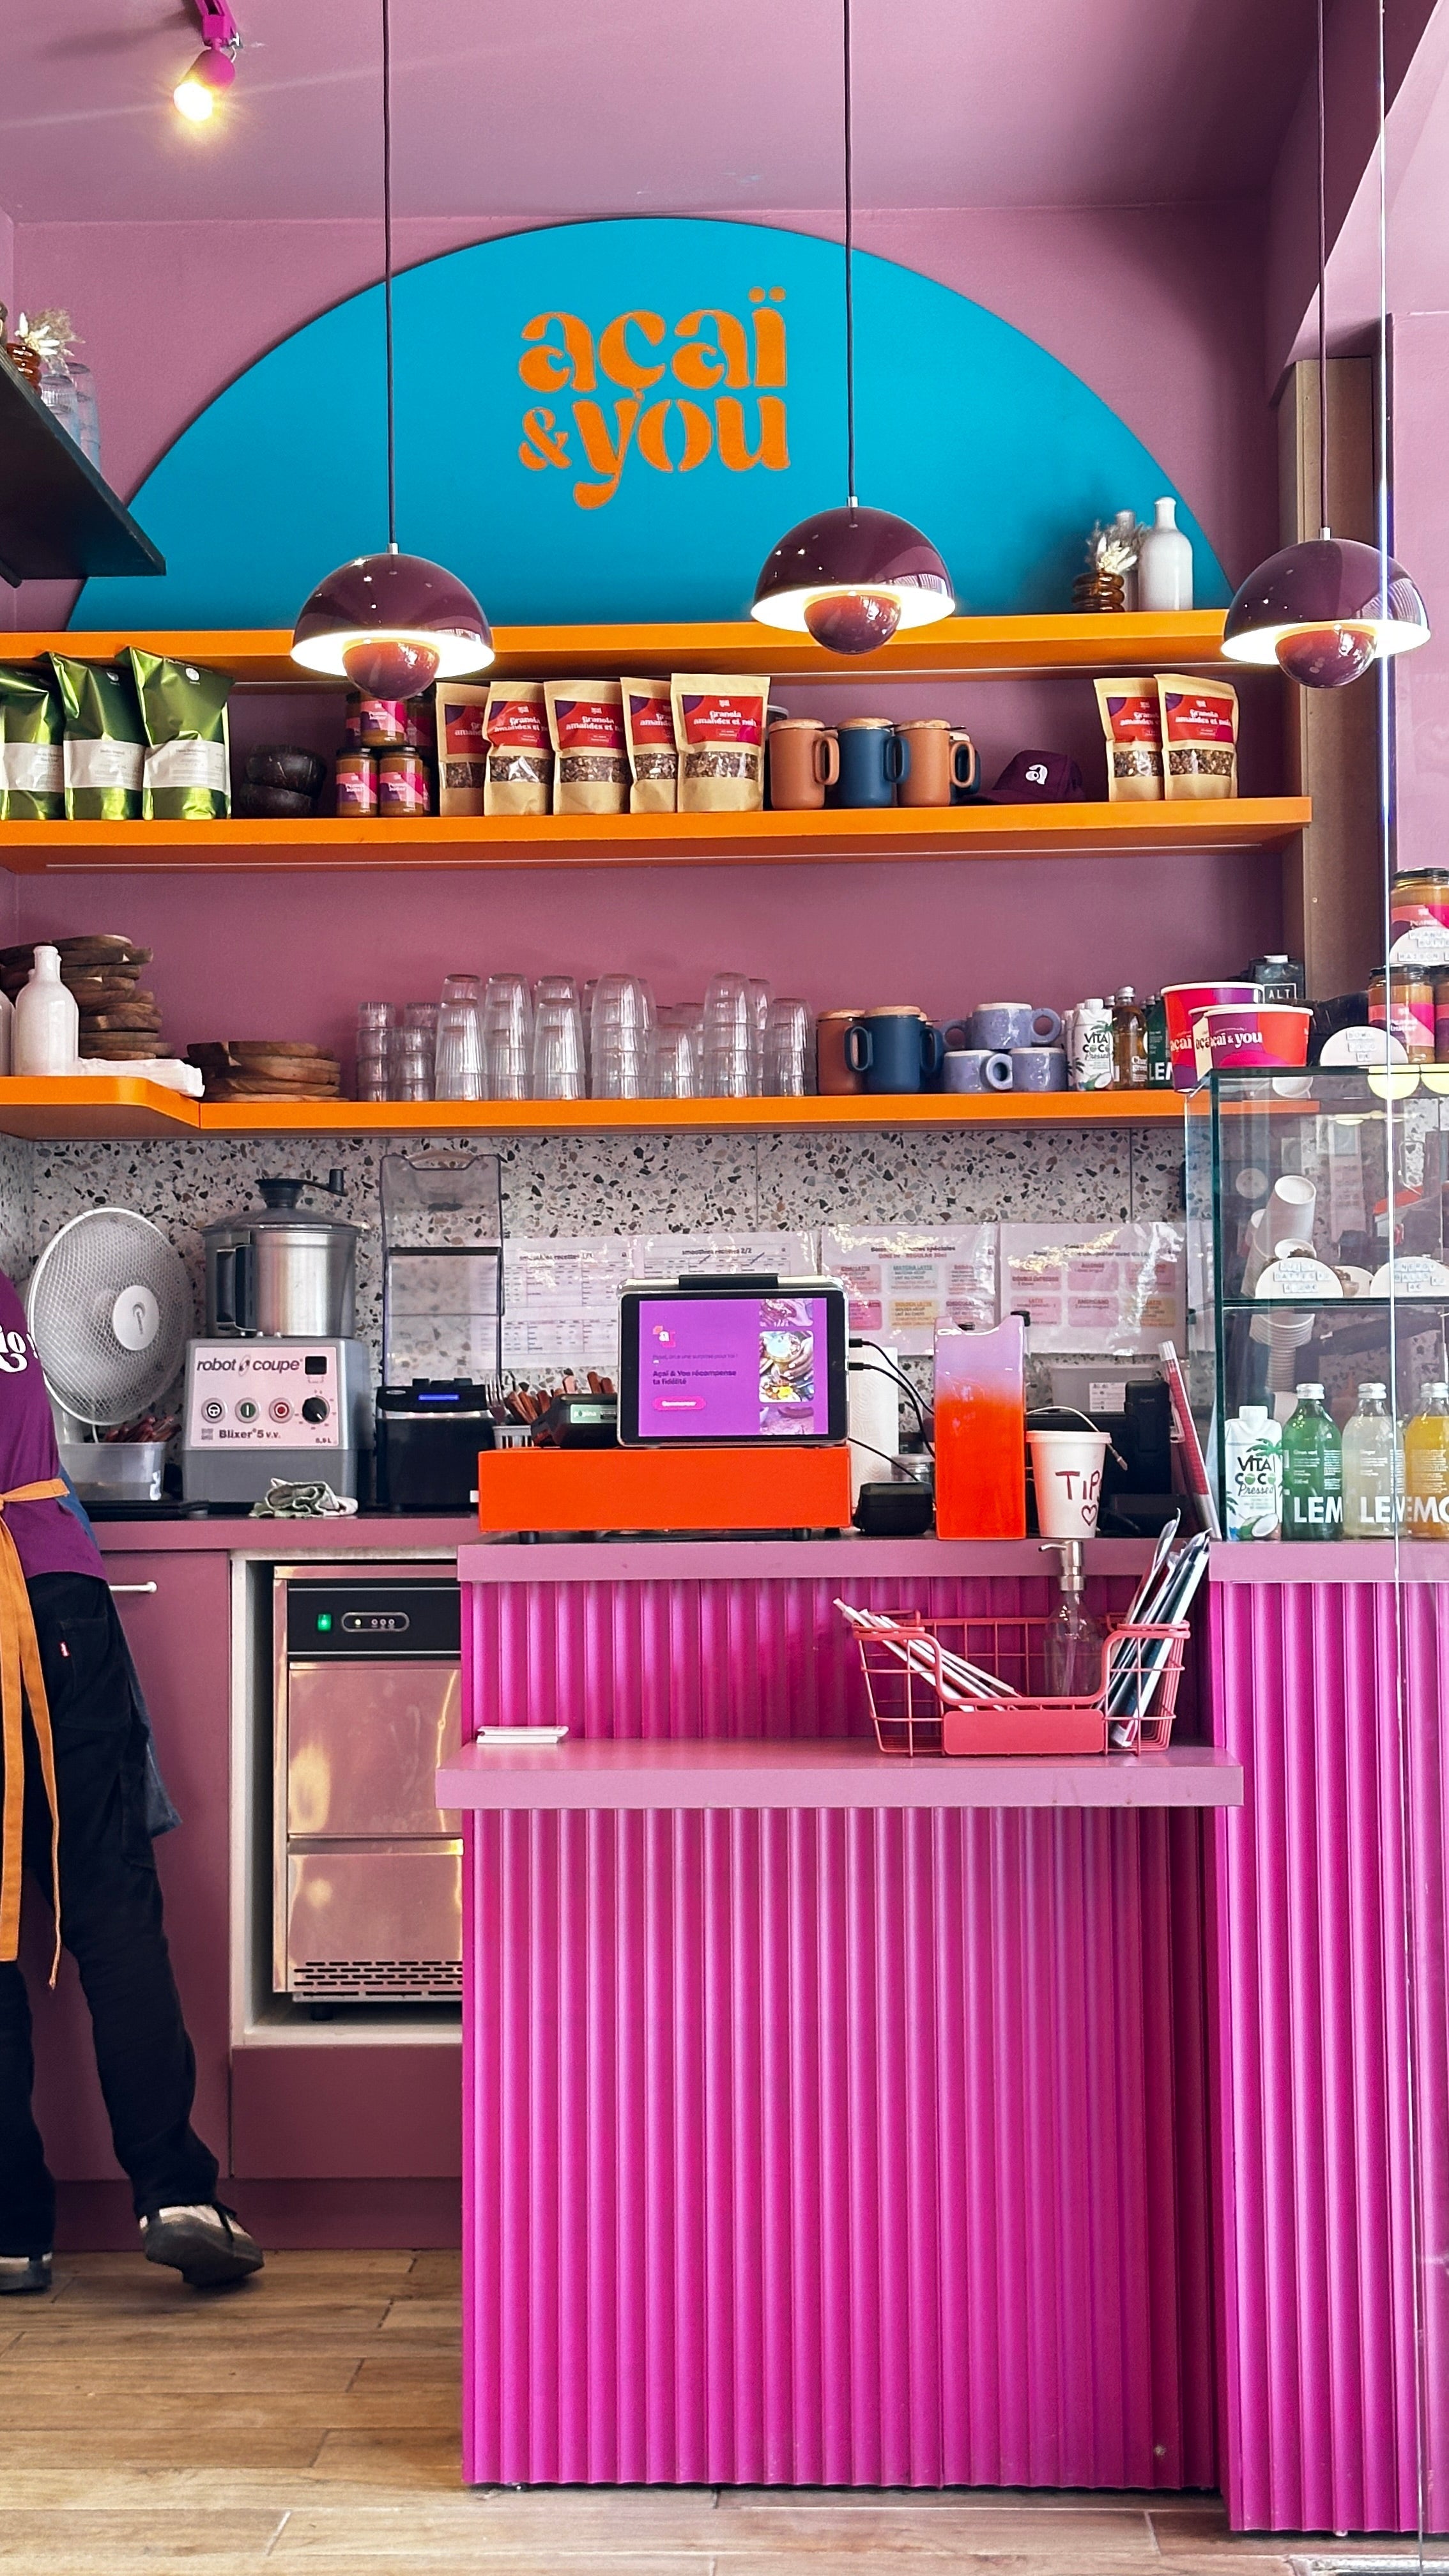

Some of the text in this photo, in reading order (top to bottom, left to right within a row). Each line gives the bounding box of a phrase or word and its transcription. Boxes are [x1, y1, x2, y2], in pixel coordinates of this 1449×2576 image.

[518, 286, 787, 401] açaï
[518, 395, 791, 510] & you
[1268, 989, 1291, 1000] ALT
[1084, 1033, 1108, 1044] VITA
[1234, 1032, 1263, 1048] you
[197, 1358, 300, 1374] robot coupe
[1237, 1454, 1273, 1471] VITA
[1234, 1472, 1276, 1485] COCO
